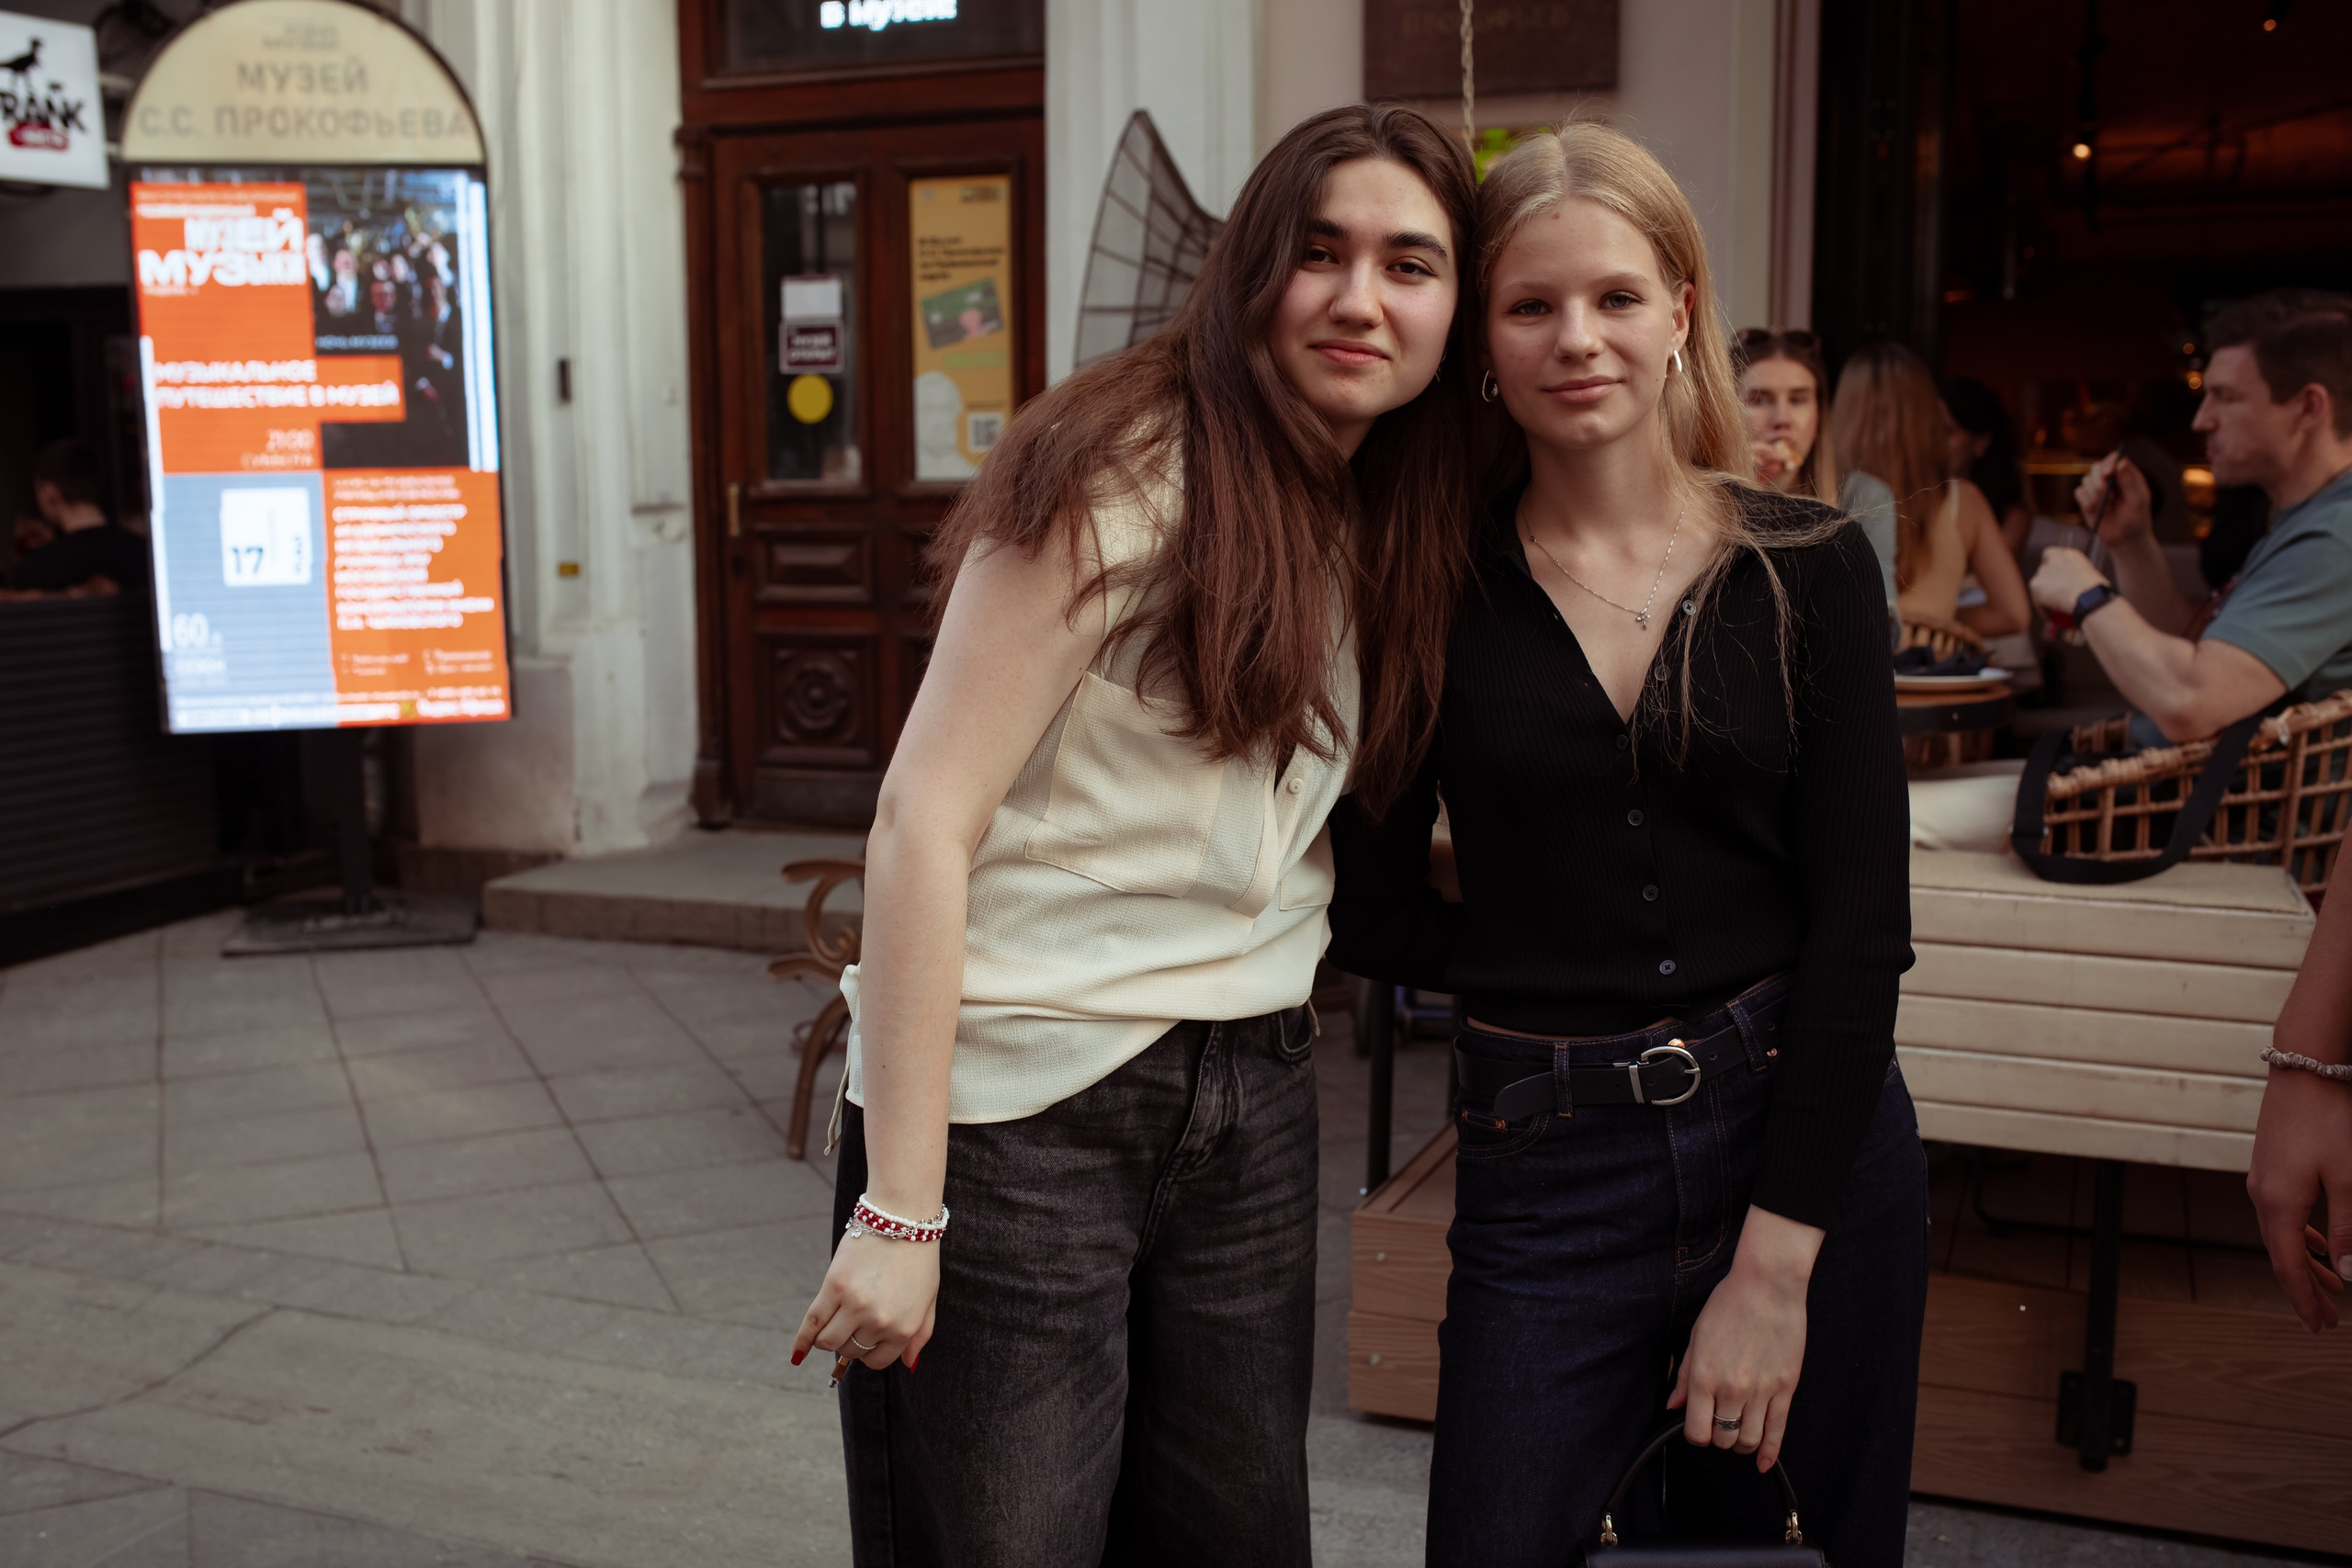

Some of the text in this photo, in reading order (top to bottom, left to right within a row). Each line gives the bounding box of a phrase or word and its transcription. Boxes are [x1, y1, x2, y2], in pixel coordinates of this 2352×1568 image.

[237, 56, 368, 93] МУЗЕЙ
[140, 106, 469, 139] С.С. ПРОКОФЬЕВА
[154, 360, 317, 384] МУЗЫКАЛЬНОЕ
[155, 379, 400, 409] ПУТЕШЕСТВИЕ В МУЗЕЙ
[231, 546, 264, 574] 17
